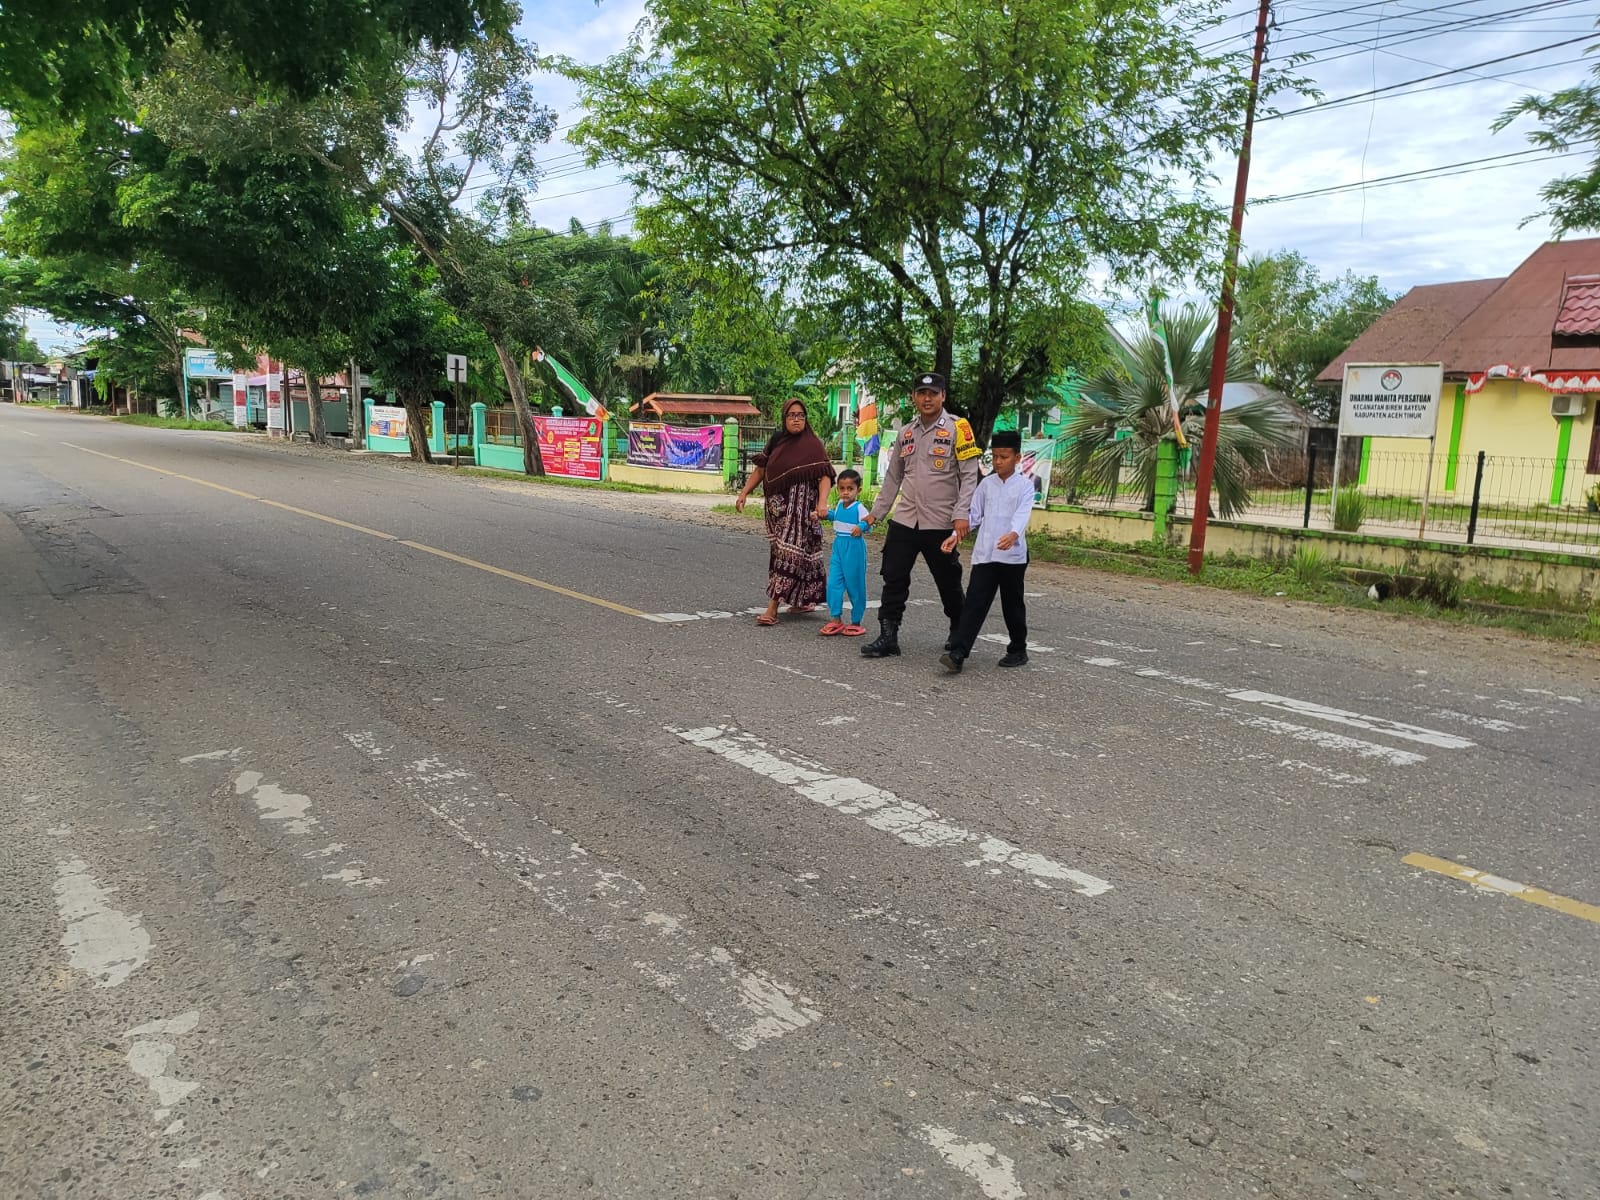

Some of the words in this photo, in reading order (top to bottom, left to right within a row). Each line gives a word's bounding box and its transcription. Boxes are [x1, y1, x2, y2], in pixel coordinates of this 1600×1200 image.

[1350, 394, 1373, 402] DHARMA
[1374, 394, 1397, 402] WANITA
[1398, 394, 1431, 403] PERSATUAN
[934, 438, 951, 446] POLRI
